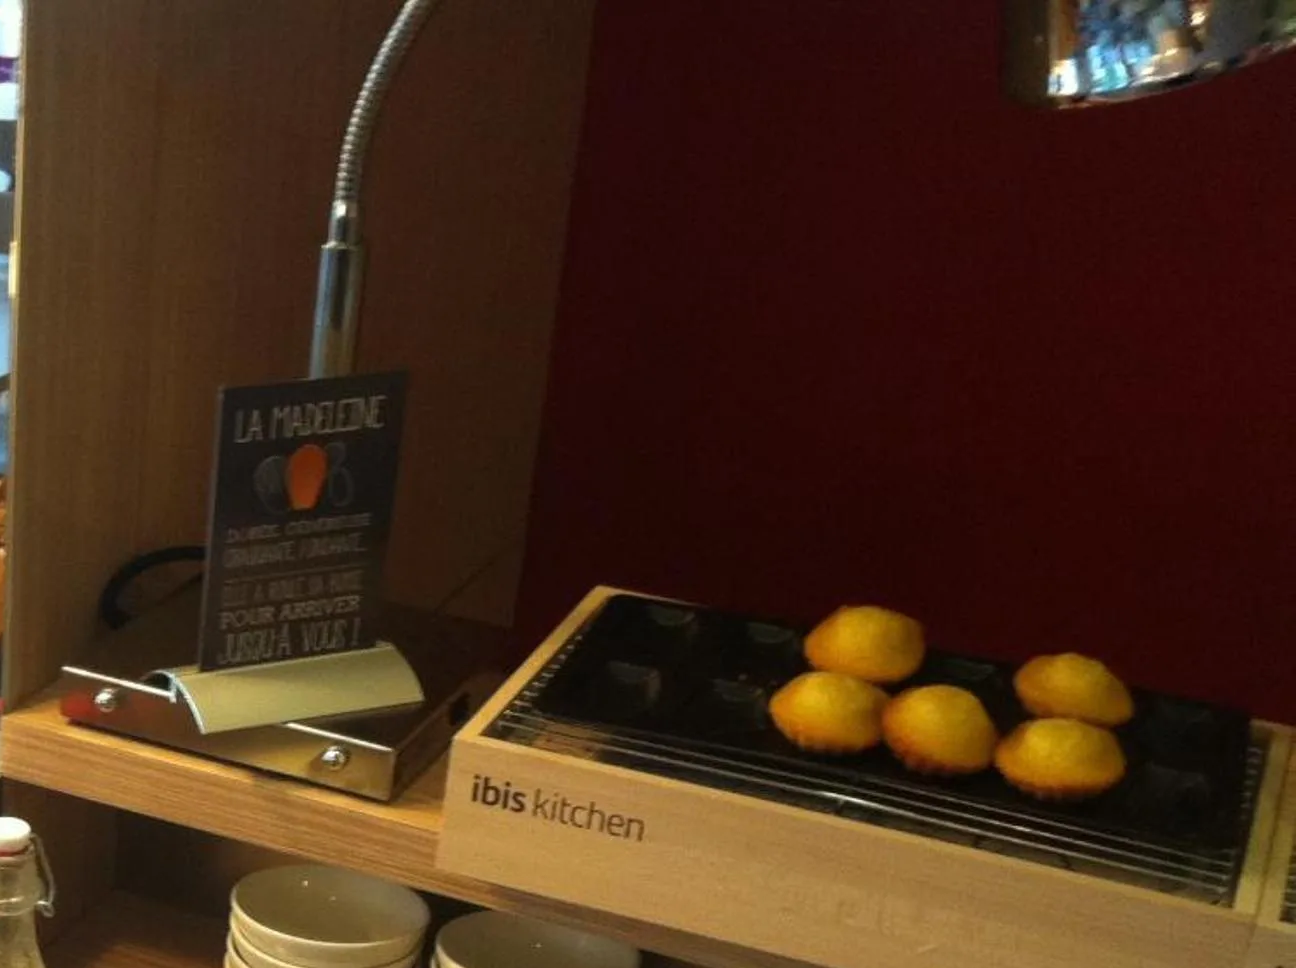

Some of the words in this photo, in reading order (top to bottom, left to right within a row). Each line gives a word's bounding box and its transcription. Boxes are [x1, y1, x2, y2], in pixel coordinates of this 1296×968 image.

[234, 407, 264, 443] LA
[270, 395, 388, 440] MADELEINE
[471, 774, 526, 813] ibis
[532, 788, 645, 842] kitchen
